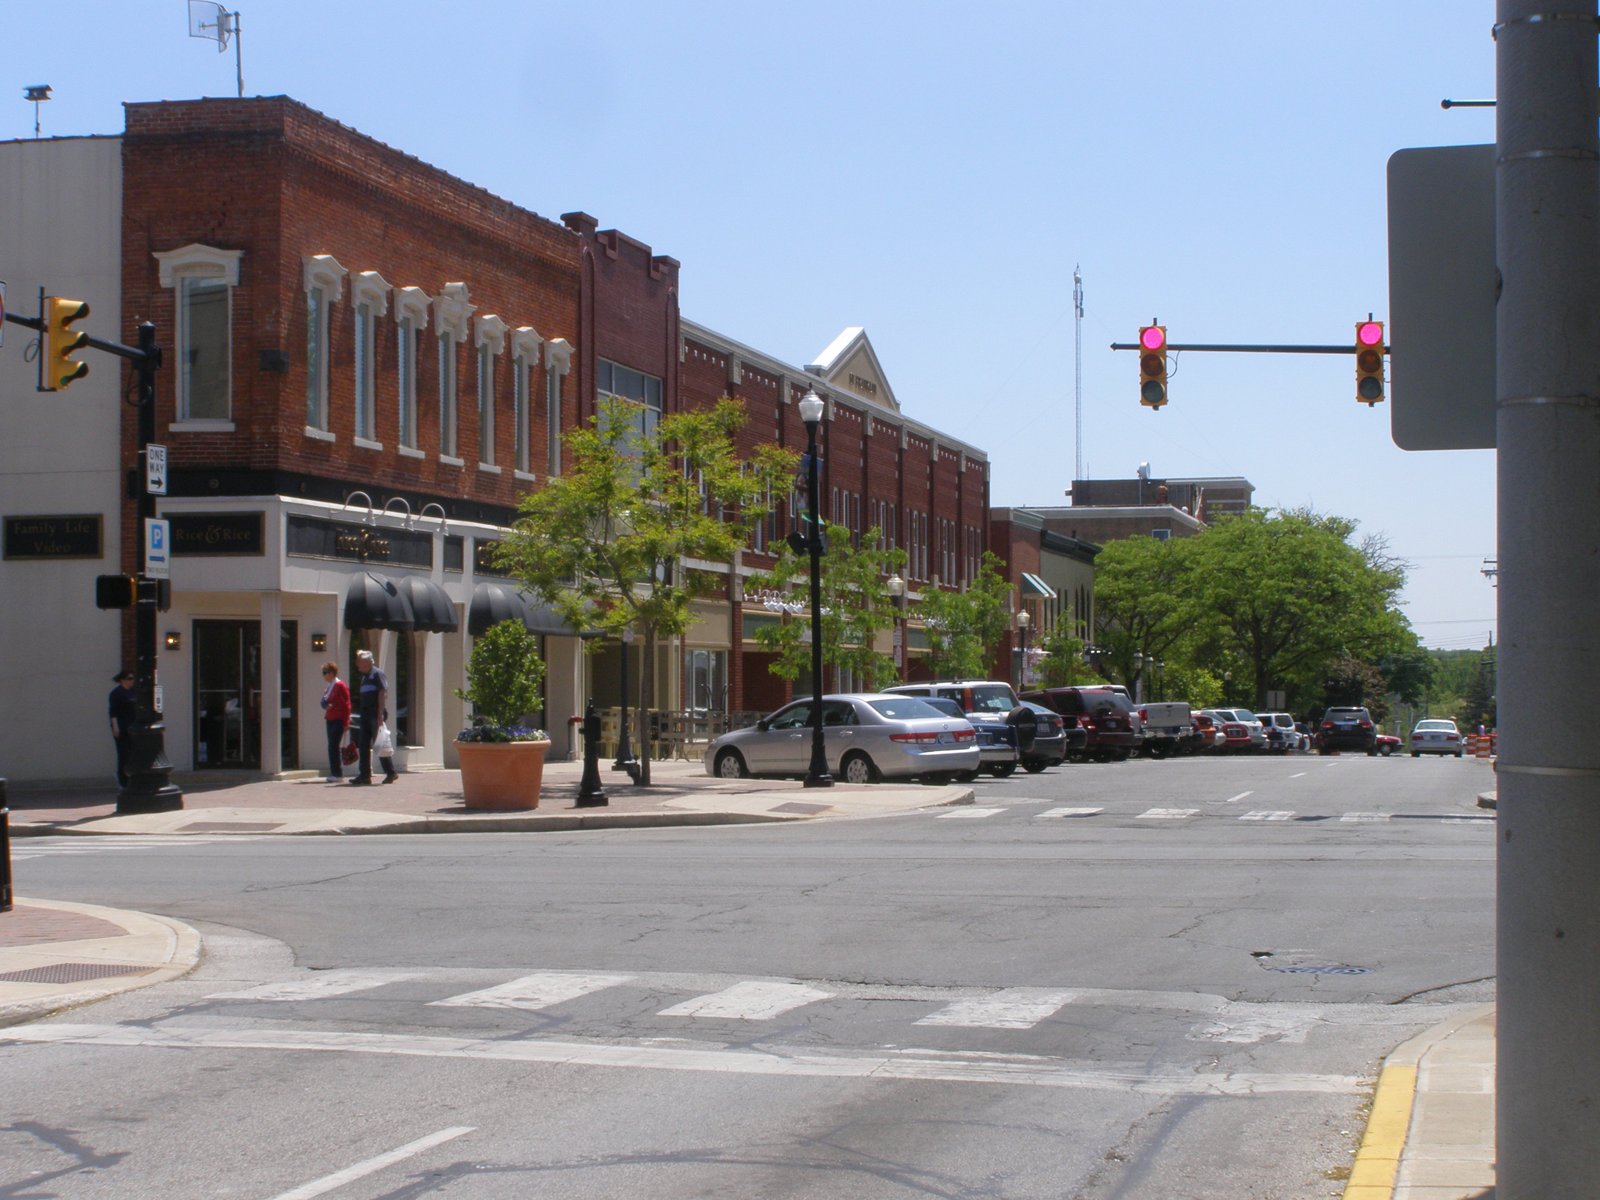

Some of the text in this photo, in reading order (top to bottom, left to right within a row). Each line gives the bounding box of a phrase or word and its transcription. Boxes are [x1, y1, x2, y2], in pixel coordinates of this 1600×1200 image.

[149, 448, 165, 462] ONE
[149, 463, 165, 475] WAY
[15, 519, 90, 537] Family Life
[175, 528, 204, 541] Rice
[222, 528, 251, 541] Rice
[153, 528, 162, 545] P
[33, 538, 71, 553] Video
